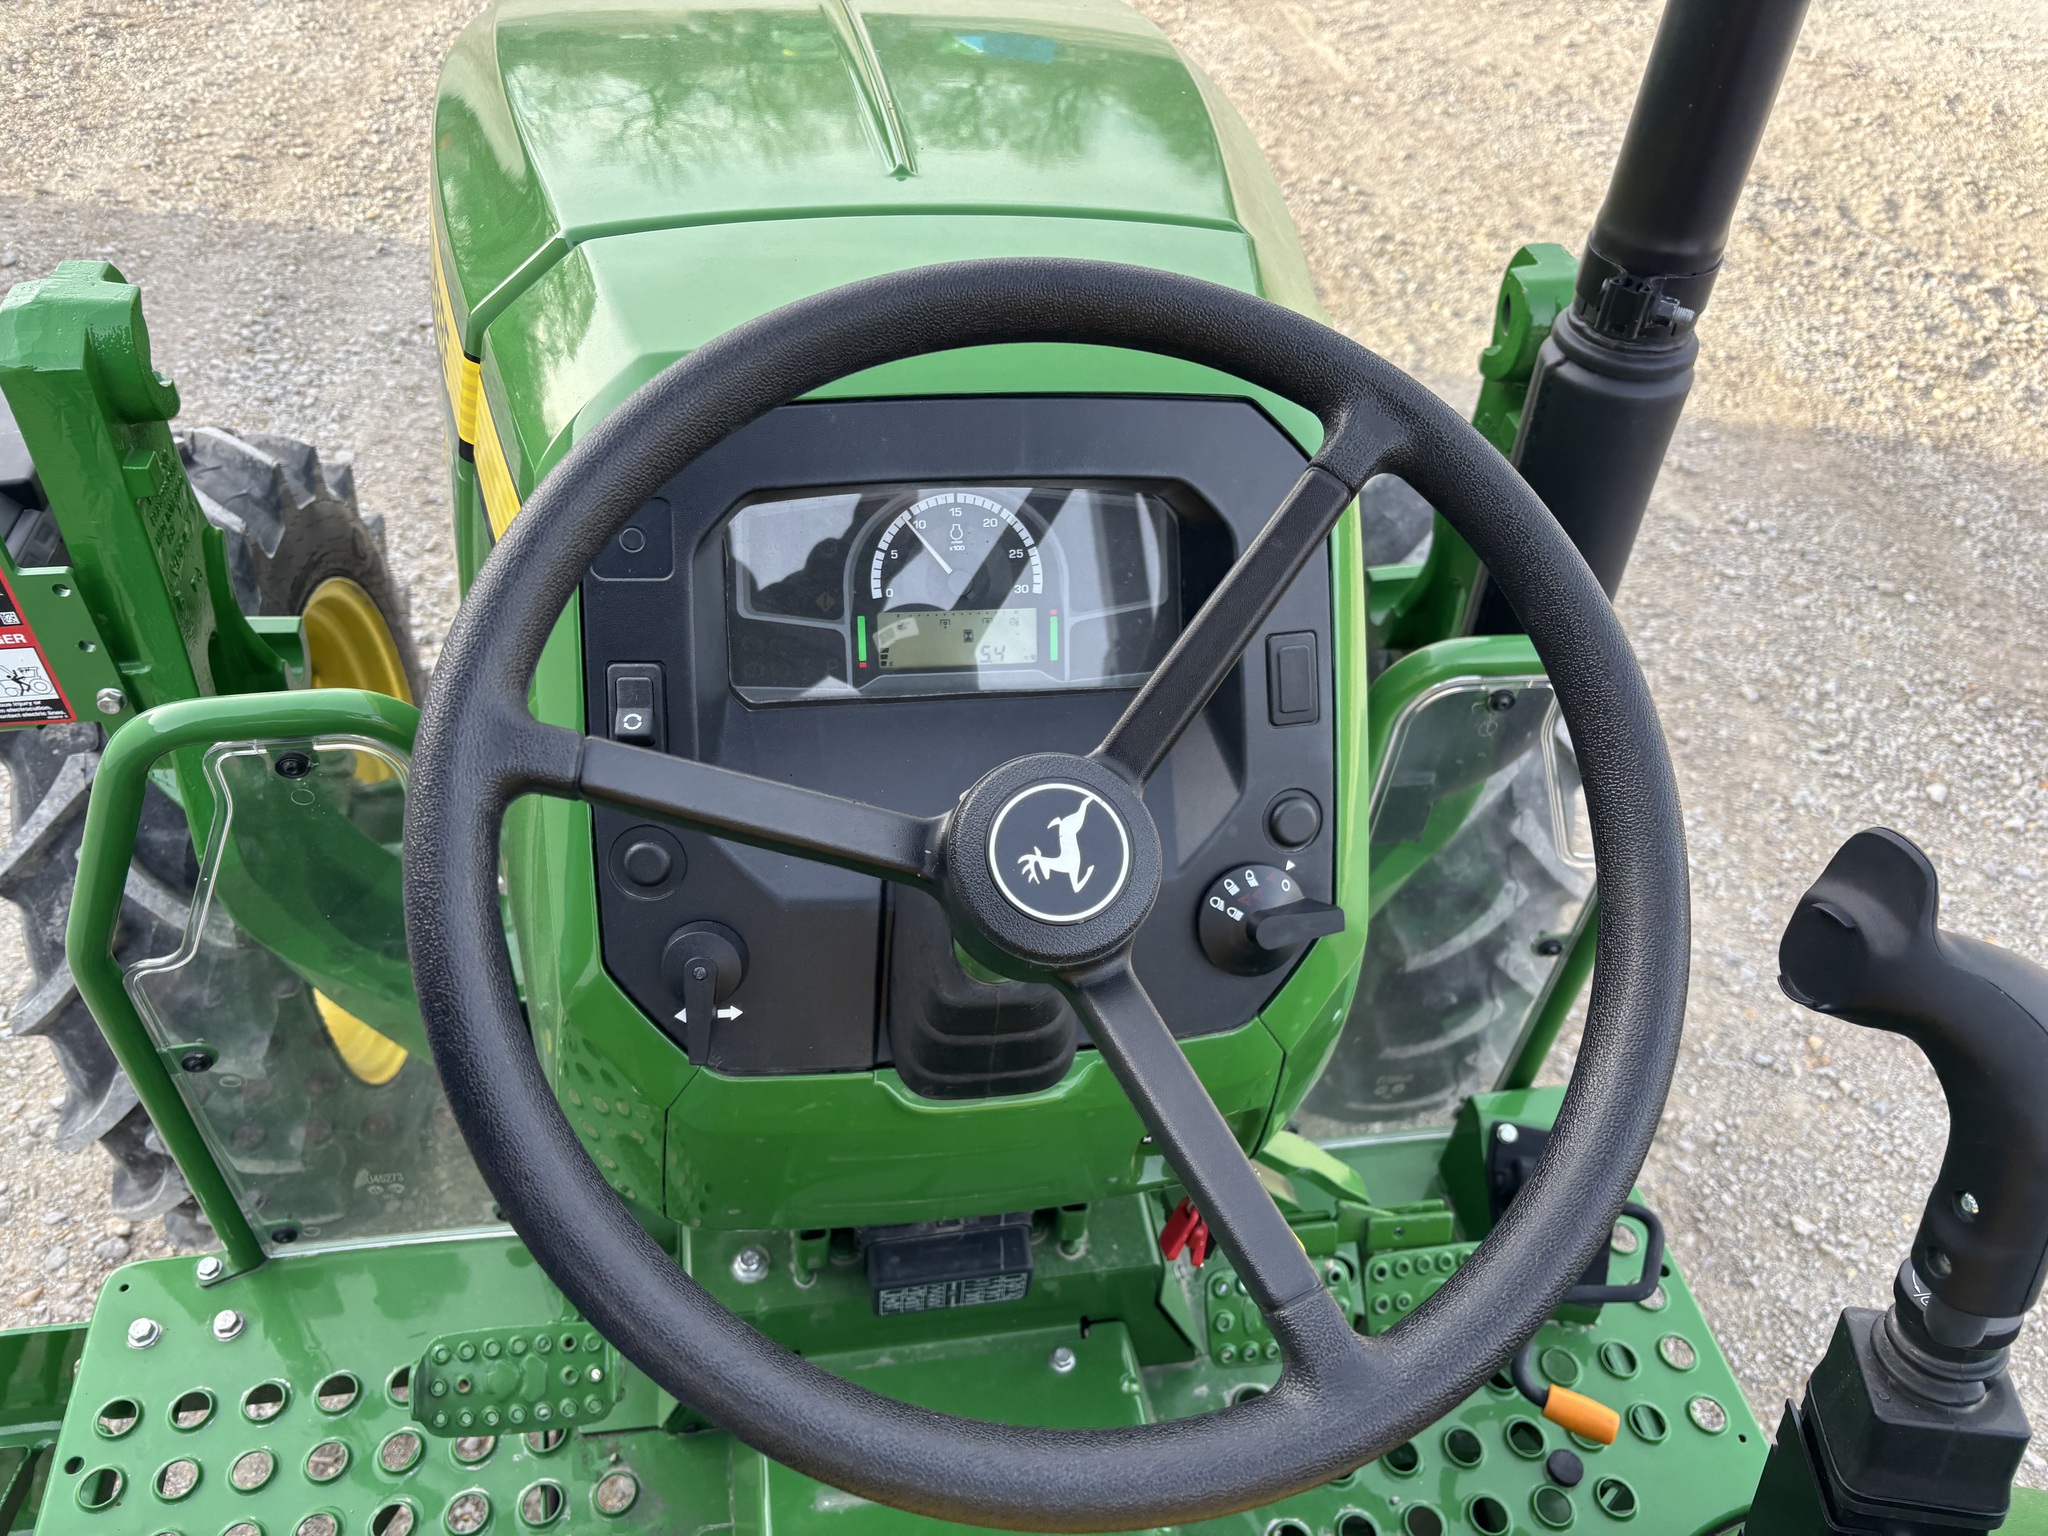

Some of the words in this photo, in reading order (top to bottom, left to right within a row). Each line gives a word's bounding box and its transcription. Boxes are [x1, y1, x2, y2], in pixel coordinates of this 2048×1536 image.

[949, 507, 962, 517] 15
[913, 519, 927, 529] 10
[983, 518, 998, 528] 20
[890, 549, 898, 559] 5
[1008, 549, 1024, 559] 25
[885, 588, 894, 598] 0
[1014, 584, 1029, 594] 30
